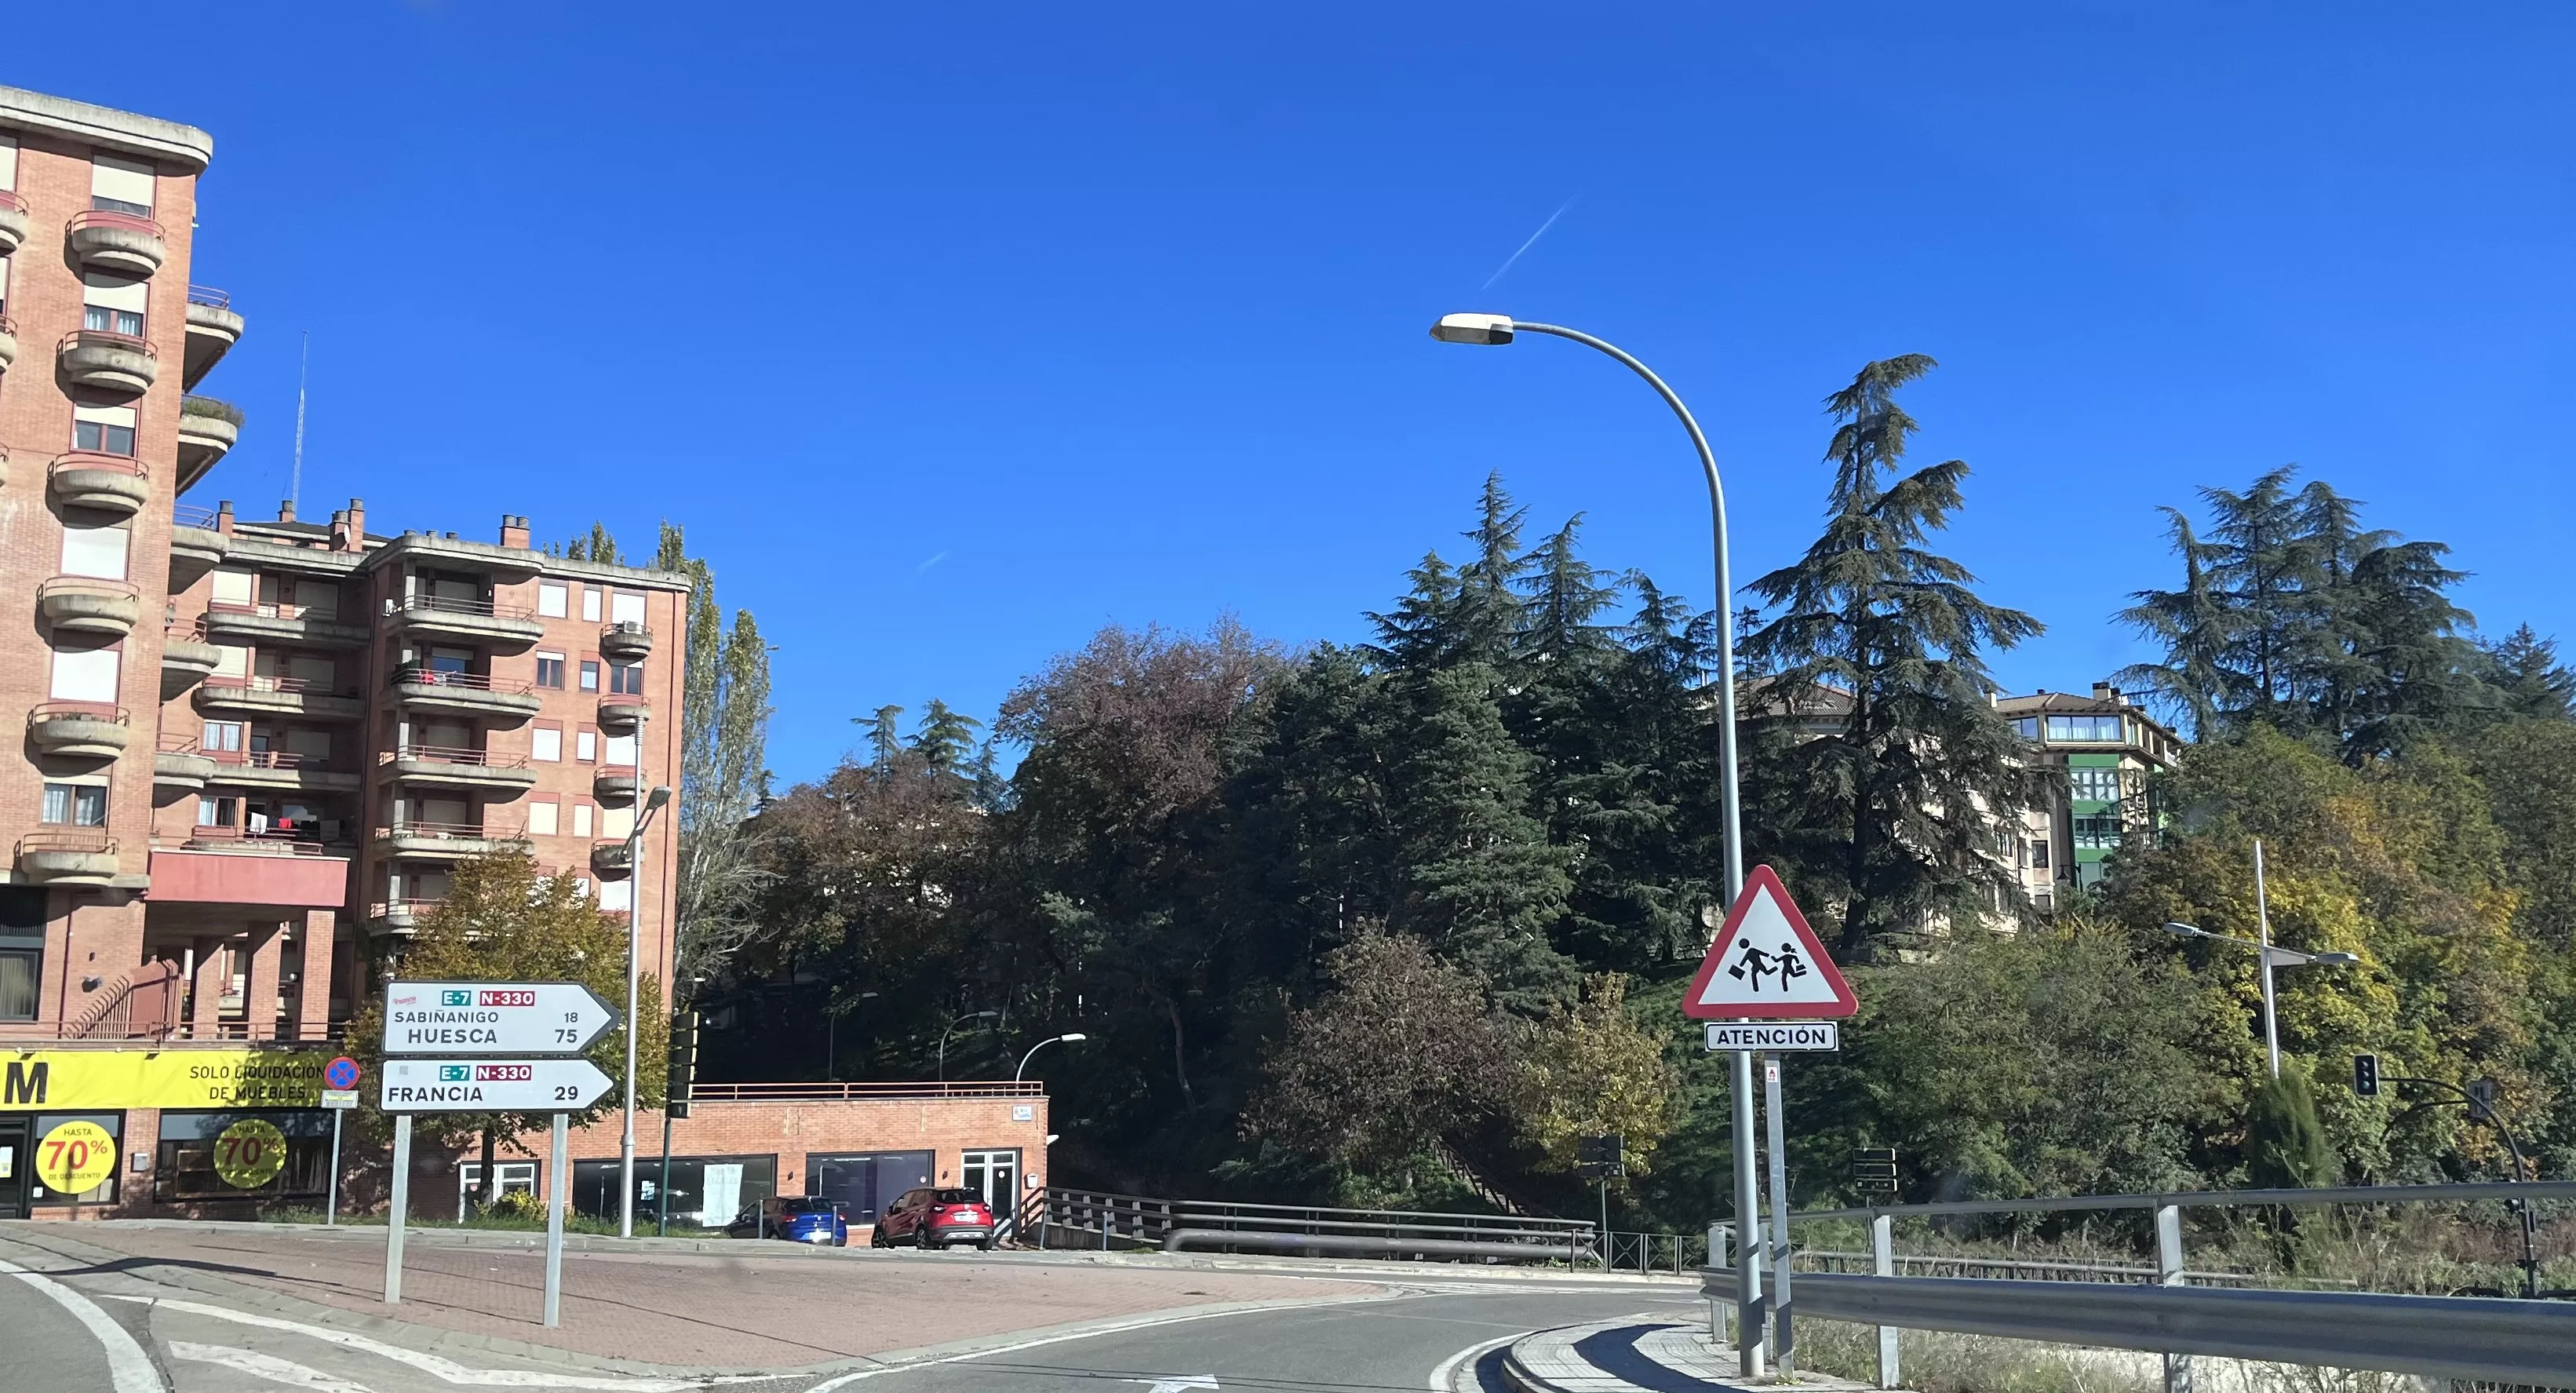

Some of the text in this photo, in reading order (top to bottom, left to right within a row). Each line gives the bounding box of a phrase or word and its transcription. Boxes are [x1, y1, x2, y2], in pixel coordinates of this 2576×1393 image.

[443, 993, 534, 1005] E-7 N-330
[394, 1009, 578, 1023] SABIÑANIGO 18
[408, 1029, 578, 1044] HUESCA 75
[1717, 1026, 1826, 1045] ATENCIÓN
[190, 1062, 325, 1079] SOLO LIQUIDACIÓN
[441, 1067, 531, 1080] E-7 N-330
[210, 1087, 305, 1099] DE MUEBLES
[388, 1086, 578, 1102] FRANCIA 29
